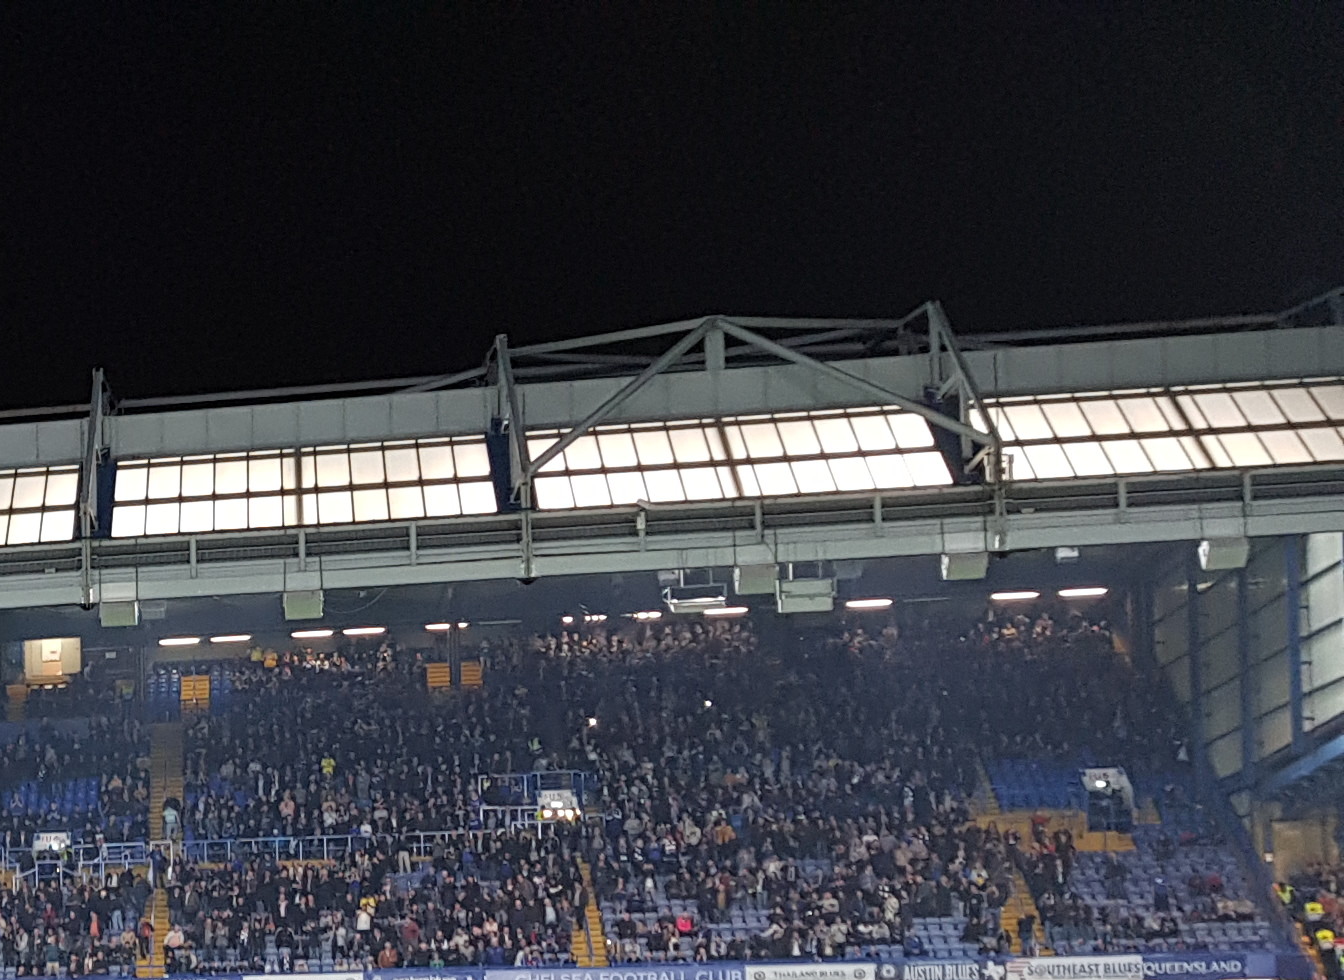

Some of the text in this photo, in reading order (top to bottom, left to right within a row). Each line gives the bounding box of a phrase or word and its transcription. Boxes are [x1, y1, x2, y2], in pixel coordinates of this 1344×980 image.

[945, 964, 980, 980] BLUES
[1027, 962, 1140, 977] SOUTHEAST BLUES
[1143, 961, 1242, 976] QUEENSLAND
